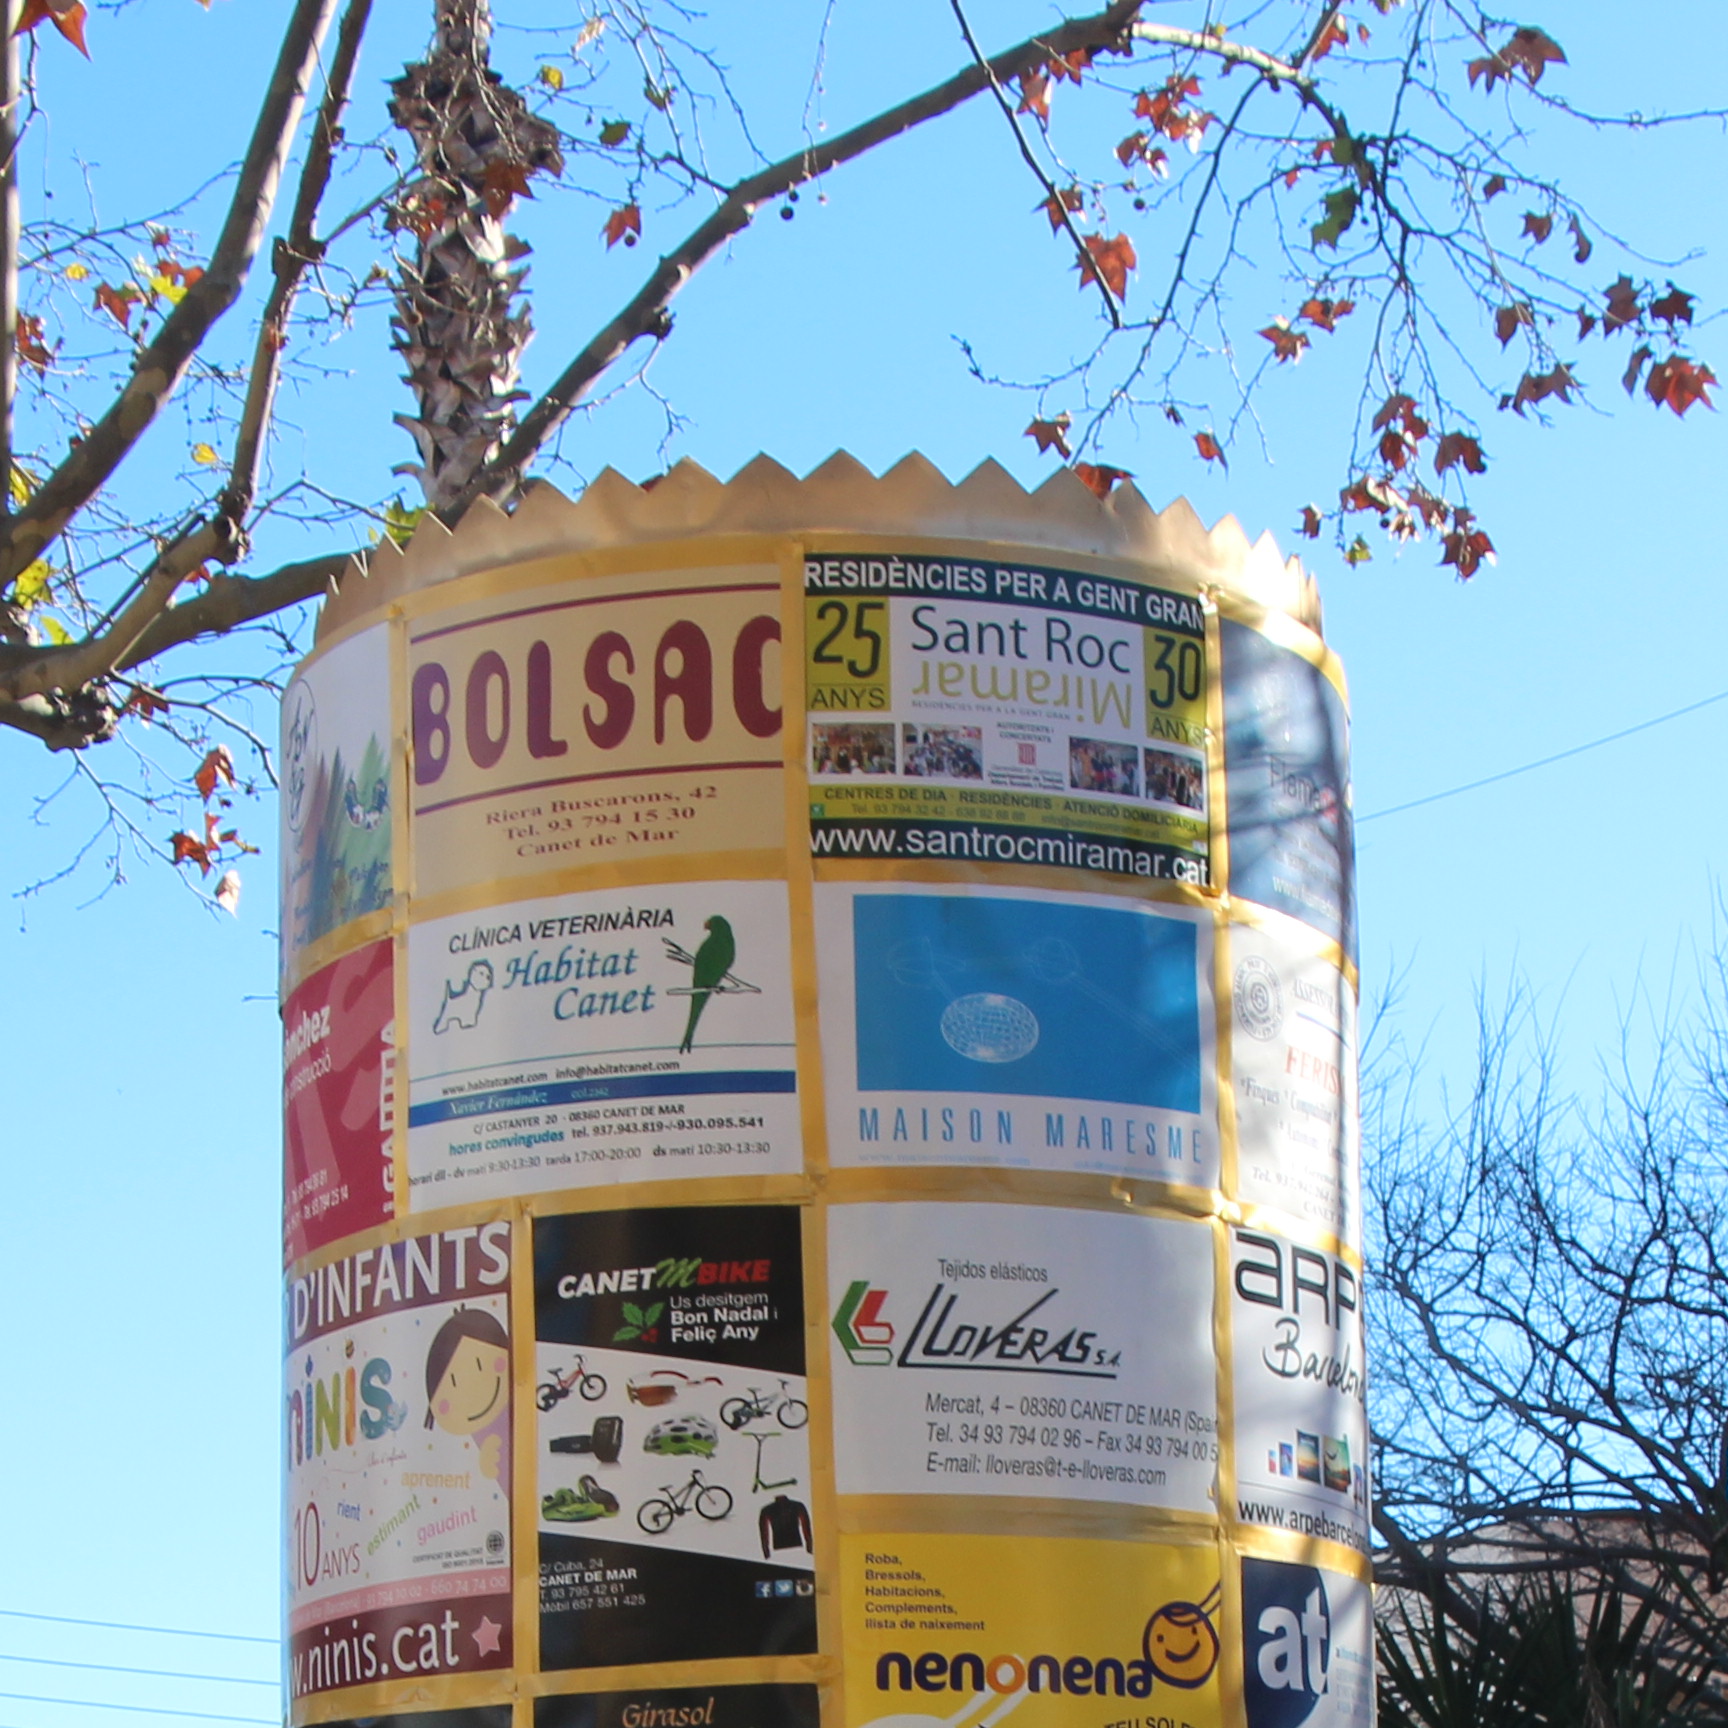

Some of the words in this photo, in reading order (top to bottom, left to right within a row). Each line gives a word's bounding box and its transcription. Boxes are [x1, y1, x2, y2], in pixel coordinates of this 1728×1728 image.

[804, 555, 987, 594] RESIDÈNCIES
[995, 569, 1047, 600] PER
[1053, 577, 1072, 604] A
[1076, 580, 1140, 615] GENT
[1145, 595, 1204, 632] GRAN
[812, 601, 885, 679] 25
[910, 604, 1027, 660] Sant
[1045, 616, 1131, 674] Roc
[1149, 633, 1202, 708] 30
[811, 687, 886, 711] ANYS
[1150, 715, 1203, 749] ANYS
[486, 804, 542, 825] Riera
[551, 788, 680, 813] Buscarons,
[689, 786, 718, 800] 42
[824, 786, 895, 802] CENTRES
[898, 788, 920, 802] DE
[922, 788, 948, 802] DIA
[959, 787, 1053, 811] RESIDÈNCIES
[505, 823, 540, 841] Tel.
[548, 818, 574, 833] 93
[583, 812, 621, 829] 794
[633, 807, 660, 823] 15
[666, 805, 696, 820] 30
[517, 837, 581, 857] Canet
[590, 831, 618, 847] de
[625, 828, 680, 843] Mar
[809, 826, 1209, 886] www.santrocmiramar.cat
[449, 925, 522, 954] CLÍNICA
[529, 907, 674, 940] VETERINÀRIA
[502, 944, 639, 990] Habitat
[553, 984, 656, 1021] Canet
[441, 1069, 548, 1097] www.habitatcanet.com
[486, 1115, 540, 1133] CASTANYER
[545, 1112, 559, 1126] 20
[603, 1105, 639, 1120] CANET
[641, 1104, 656, 1117] DE
[658, 1102, 685, 1116] MAR
[697, 1140, 771, 1156] 10:30-13:30
[859, 1107, 1013, 1145] MAISON
[1045, 1112, 1203, 1164] MARESME
[938, 1258, 986, 1283] Tejidos
[990, 1259, 1048, 1283] elásticos
[669, 1296, 691, 1310] Us
[695, 1291, 769, 1312] desitgem
[671, 1309, 710, 1326] Bon
[714, 1306, 770, 1324] Nadal
[671, 1326, 718, 1345] Feliç
[722, 1323, 759, 1343] Any
[926, 1393, 985, 1418] Mercat,
[990, 1396, 1000, 1415] 4
[1019, 1396, 1067, 1418] 08360
[1070, 1399, 1121, 1423] CANET
[1126, 1404, 1147, 1425] DE
[1149, 1406, 1182, 1428] MAR
[927, 1422, 954, 1443] Tel.
[959, 1424, 979, 1444] 34
[984, 1425, 1004, 1445] 93
[1008, 1425, 1037, 1446] 794
[1040, 1427, 1060, 1447] 02
[1062, 1428, 1082, 1448] 96
[1097, 1431, 1122, 1453] Fax
[1125, 1433, 1143, 1454] 34
[1145, 1435, 1163, 1456] 93
[1166, 1437, 1189, 1459] 794
[1190, 1440, 1209, 1461] 00
[400, 1469, 472, 1492] aprenent
[926, 1452, 981, 1475] E-mail:
[985, 1453, 1167, 1487] lloveras@t-e-lloveras.com
[336, 1497, 362, 1521] rient
[416, 1504, 479, 1545] gaudint
[365, 1493, 422, 1557] estimant
[293, 1500, 322, 1592] 10
[322, 1541, 361, 1580] ANYS
[865, 1552, 904, 1567] Roba,
[539, 1572, 581, 1589] CANET
[584, 1570, 604, 1584] DE
[607, 1567, 638, 1583] MAR
[589, 1558, 605, 1570] 24
[865, 1569, 926, 1583] Bressols,
[551, 1586, 566, 1600] 93
[569, 1585, 592, 1599] 795
[594, 1583, 609, 1596] 42
[610, 1581, 626, 1595] 61
[572, 1598, 594, 1613] 657
[597, 1596, 620, 1610] 551
[623, 1594, 646, 1608] 425
[865, 1585, 946, 1599] Habitacions,
[865, 1602, 958, 1616] Complements,
[899, 1619, 917, 1632] de
[919, 1619, 986, 1633] naixement
[1257, 1586, 1328, 1695] at
[622, 1696, 715, 1728] Girasol
